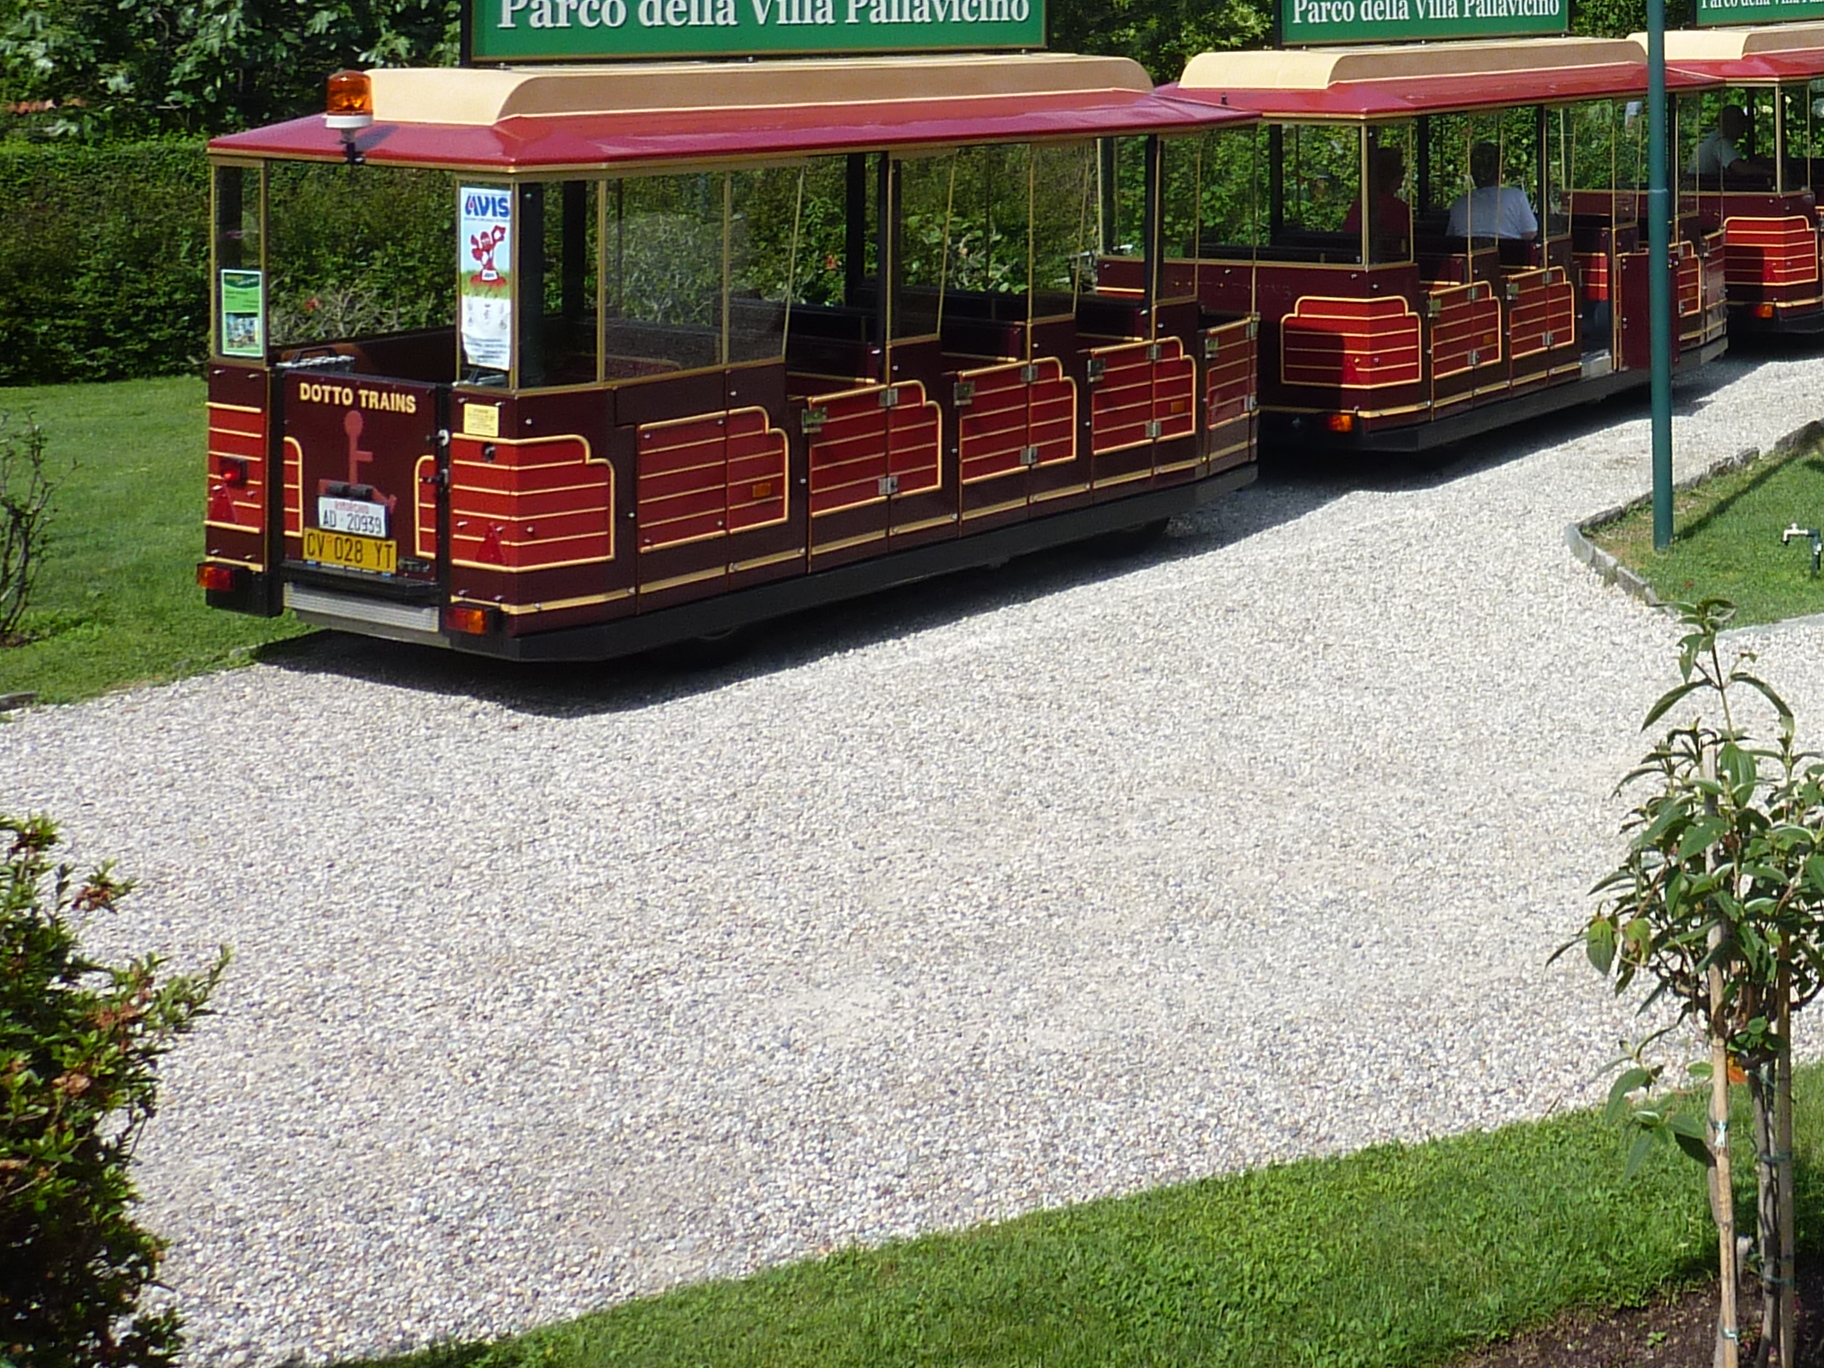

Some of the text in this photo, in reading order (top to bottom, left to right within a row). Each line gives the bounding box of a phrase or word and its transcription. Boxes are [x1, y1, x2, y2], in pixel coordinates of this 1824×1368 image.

[465, 195, 510, 218] AVIS
[299, 382, 416, 414] DOTTO TRAINS
[323, 509, 337, 527] AD
[307, 533, 325, 557] CV
[334, 536, 363, 563] 028
[374, 542, 393, 568] YT
